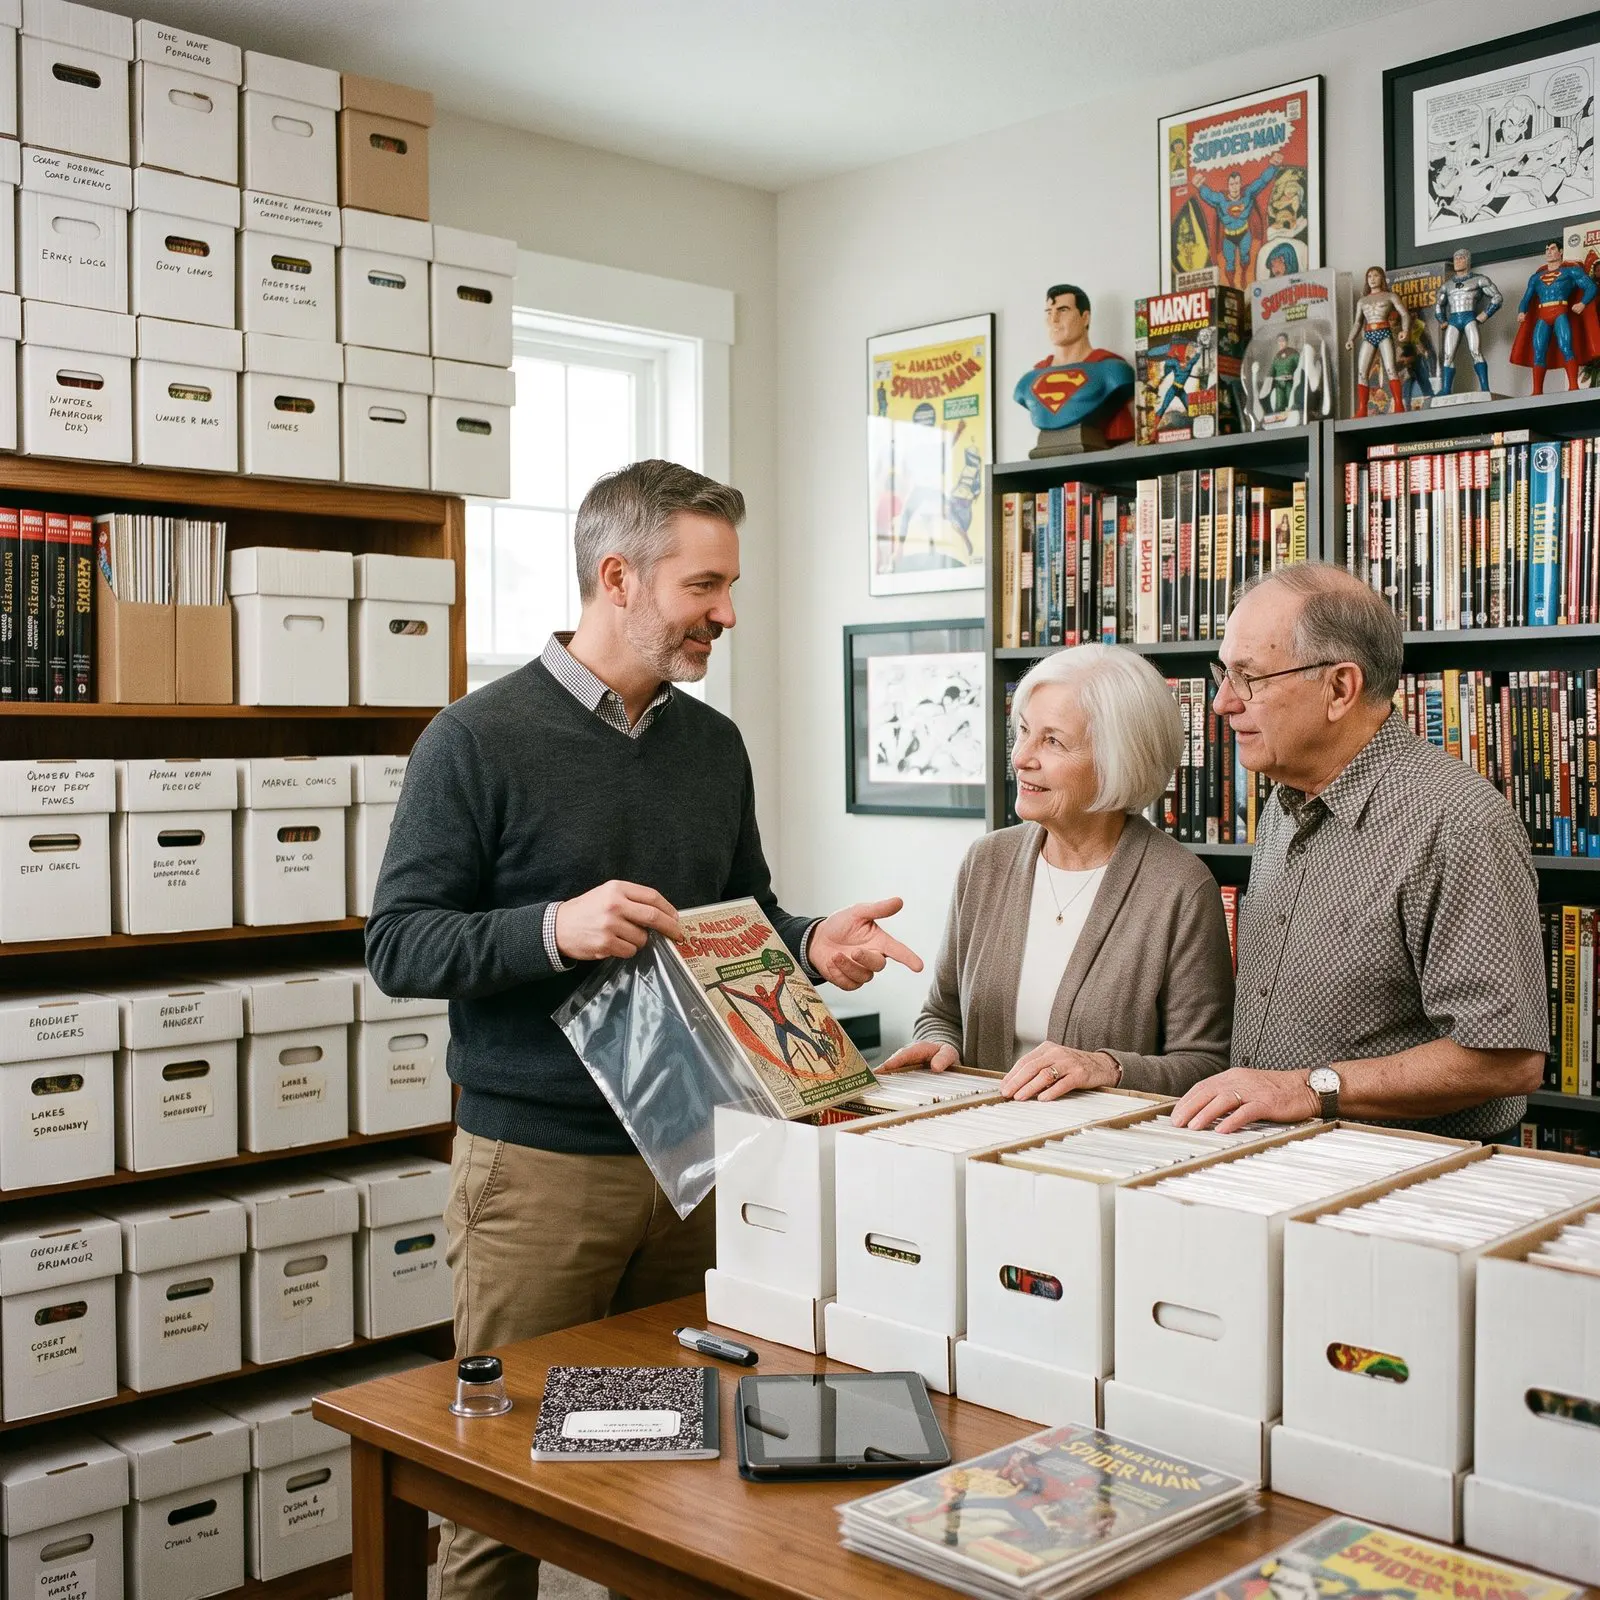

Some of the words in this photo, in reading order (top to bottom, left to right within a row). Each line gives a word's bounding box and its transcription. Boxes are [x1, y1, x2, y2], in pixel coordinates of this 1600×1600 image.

[1150, 292, 1209, 328] MARVEL
[262, 778, 299, 788] MARVEL
[305, 777, 337, 786] COMICS
[1060, 1440, 1202, 1491] SPIDER-MAN
[1104, 1443, 1189, 1474] AMAZING
[1395, 1545, 1513, 1585] AMAZING
